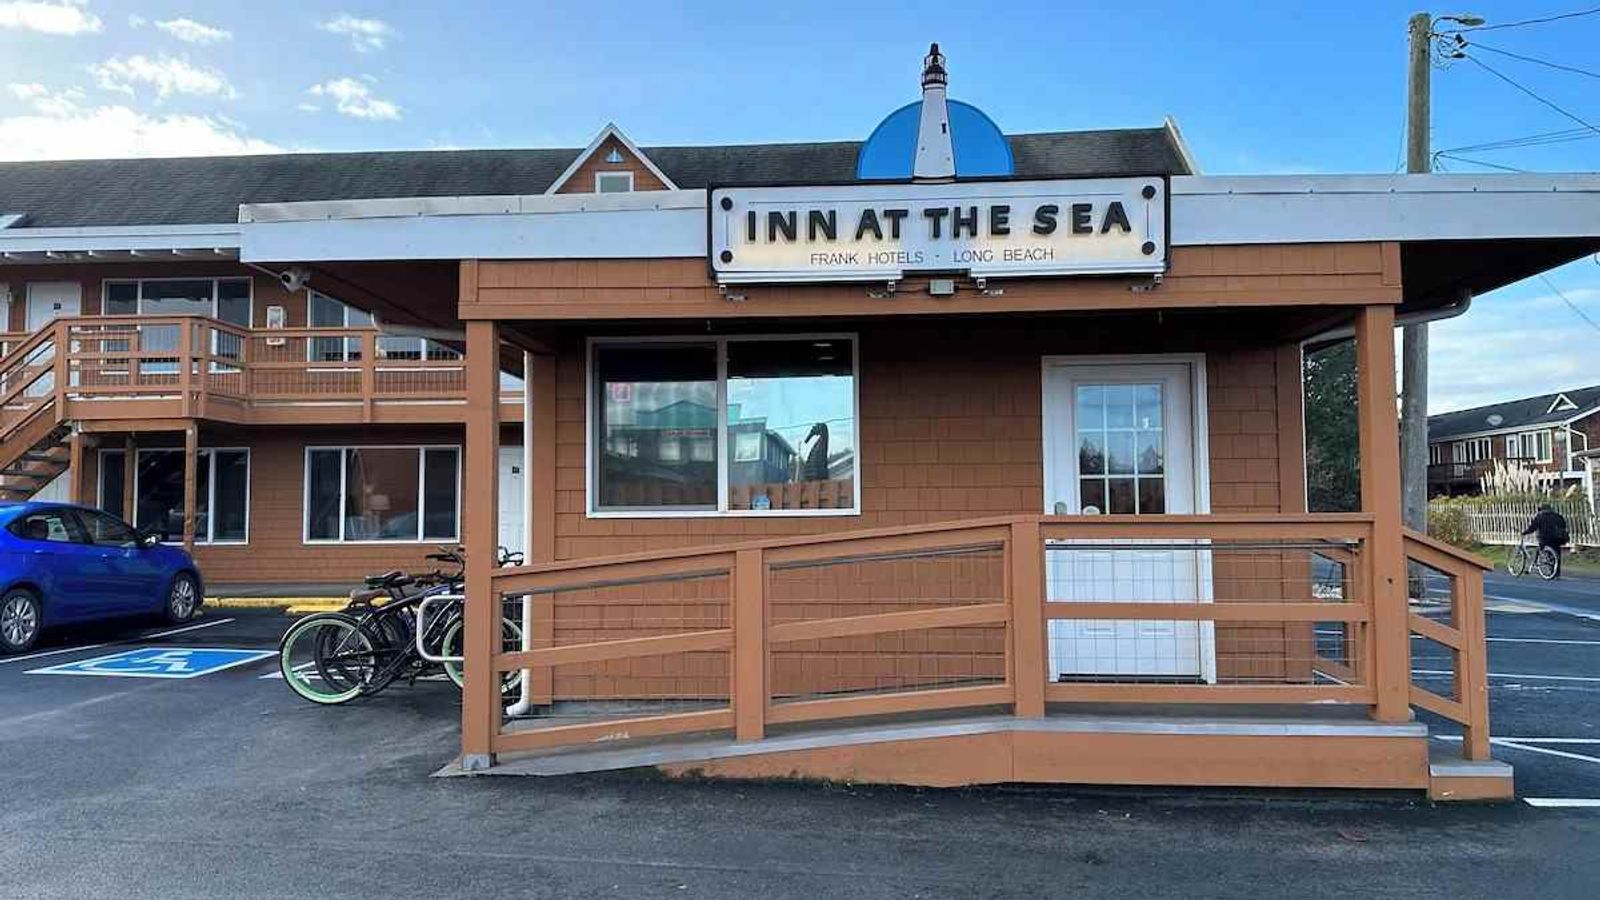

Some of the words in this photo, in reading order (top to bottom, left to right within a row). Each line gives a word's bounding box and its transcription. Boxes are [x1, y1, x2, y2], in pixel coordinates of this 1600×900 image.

[746, 209, 837, 242] INN
[855, 207, 909, 242] AT
[923, 205, 1011, 239] THE
[1032, 201, 1132, 235] SEA
[810, 253, 859, 265] FRANK
[868, 251, 925, 265] HOTELS
[953, 249, 994, 263] LONG
[1003, 247, 1055, 262] BEACH
